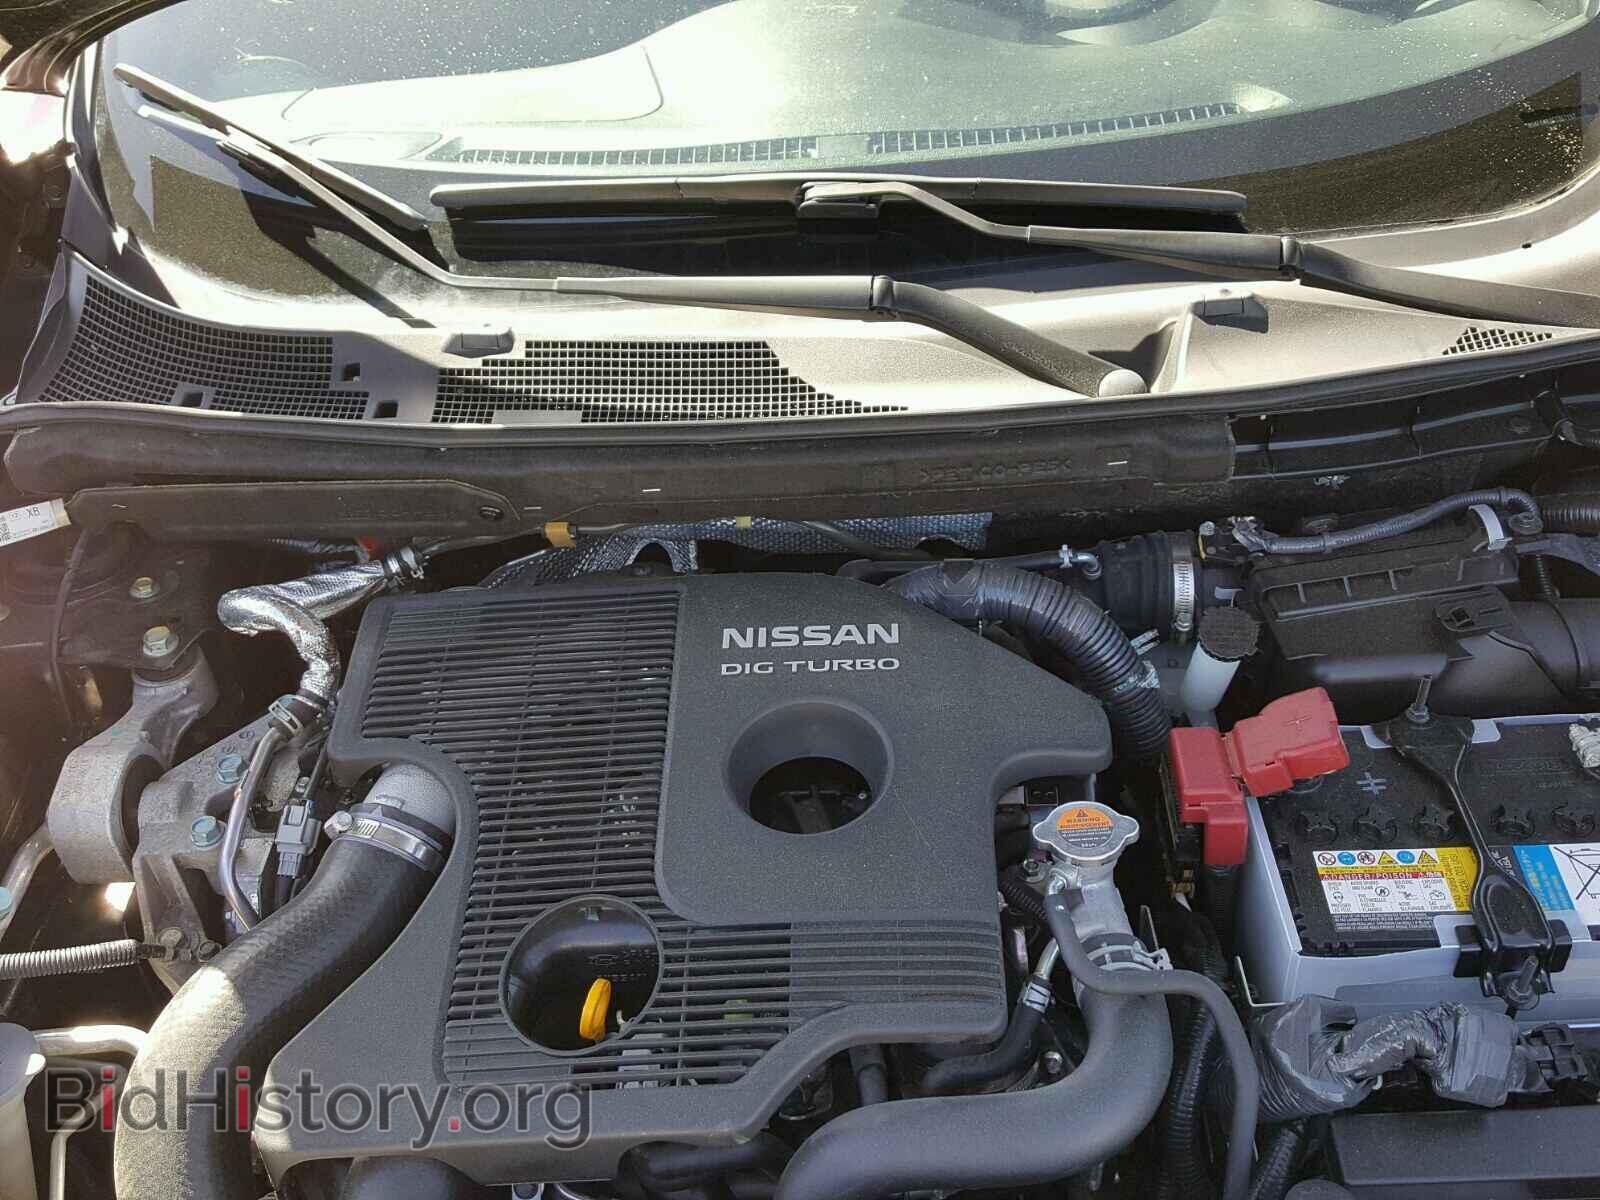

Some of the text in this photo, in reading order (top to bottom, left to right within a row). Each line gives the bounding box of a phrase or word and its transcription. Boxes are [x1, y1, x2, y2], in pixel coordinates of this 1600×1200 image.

[722, 623, 900, 649] NISSAN
[721, 657, 900, 676] DIG TURBO
